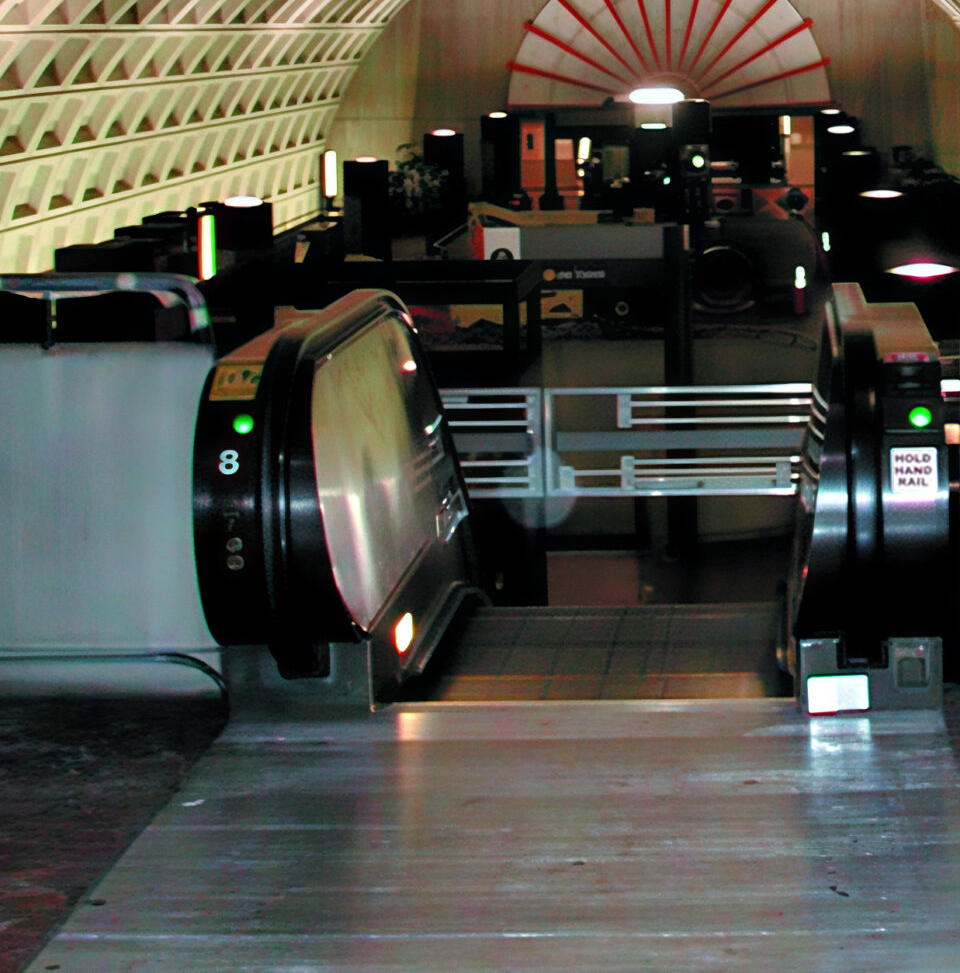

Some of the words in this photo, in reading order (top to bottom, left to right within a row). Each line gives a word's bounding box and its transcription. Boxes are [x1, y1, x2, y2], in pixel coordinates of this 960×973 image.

[218, 449, 240, 476] 8
[894, 453, 931, 463] HOLD
[894, 465, 932, 475] HAND
[898, 477, 929, 487] RAIL
